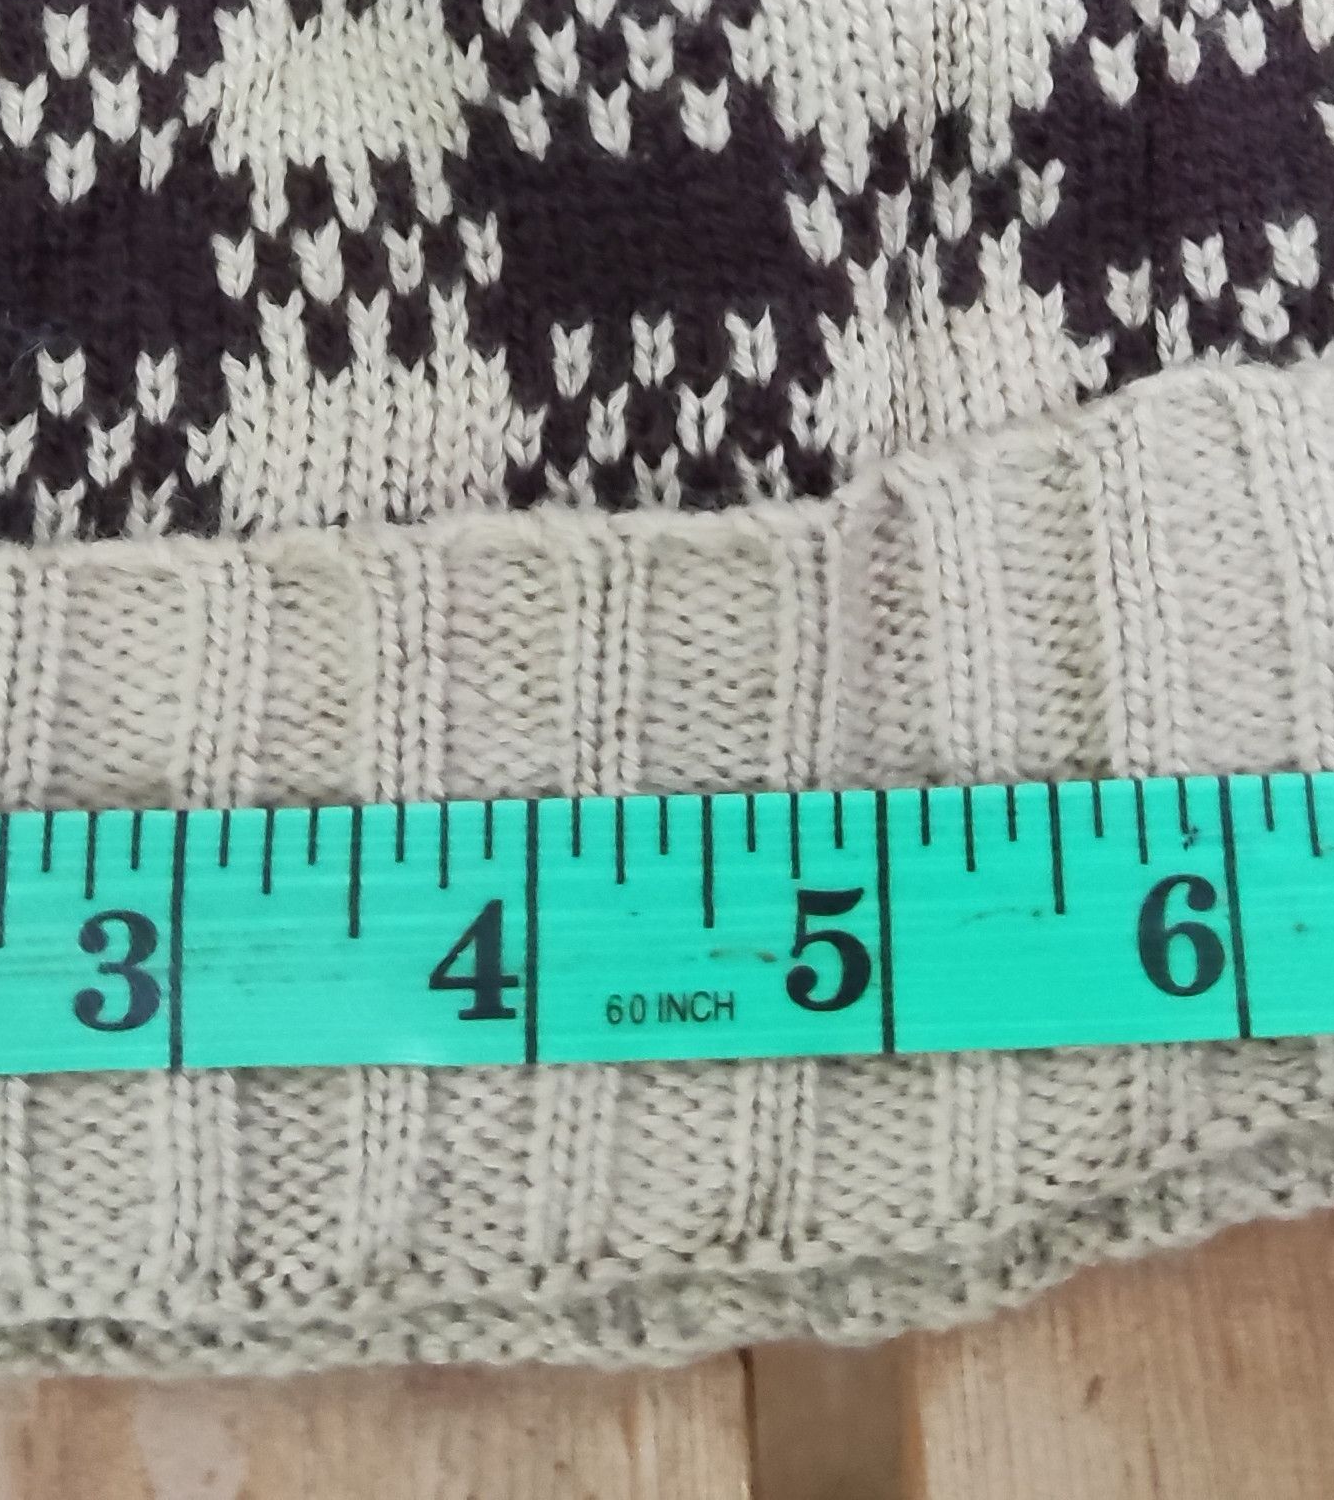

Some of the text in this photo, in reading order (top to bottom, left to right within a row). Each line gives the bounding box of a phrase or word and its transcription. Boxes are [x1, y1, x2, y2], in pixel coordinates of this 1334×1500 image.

[72, 909, 162, 1032] 3
[428, 898, 520, 1021] 4
[785, 887, 872, 1012] 5
[1136, 873, 1226, 997] 6
[604, 991, 735, 1025] 60 INCH
